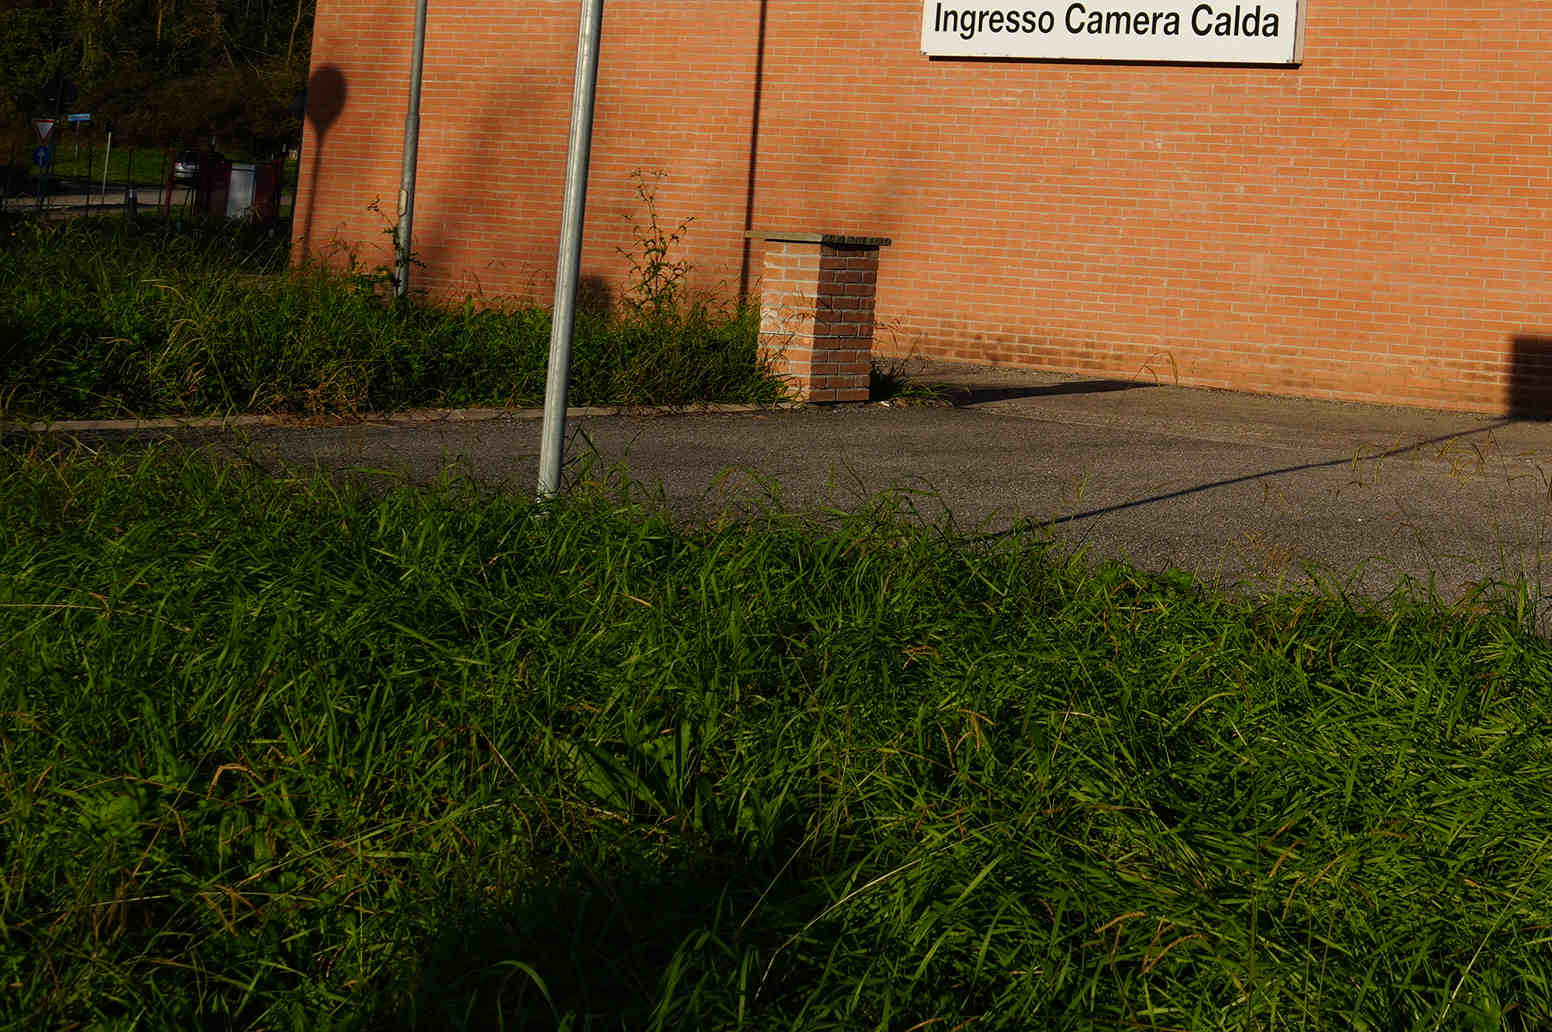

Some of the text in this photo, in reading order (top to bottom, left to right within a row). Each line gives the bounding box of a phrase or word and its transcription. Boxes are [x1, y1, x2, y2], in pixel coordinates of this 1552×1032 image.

[934, 2, 1280, 40] Ingresso Camera Calda
